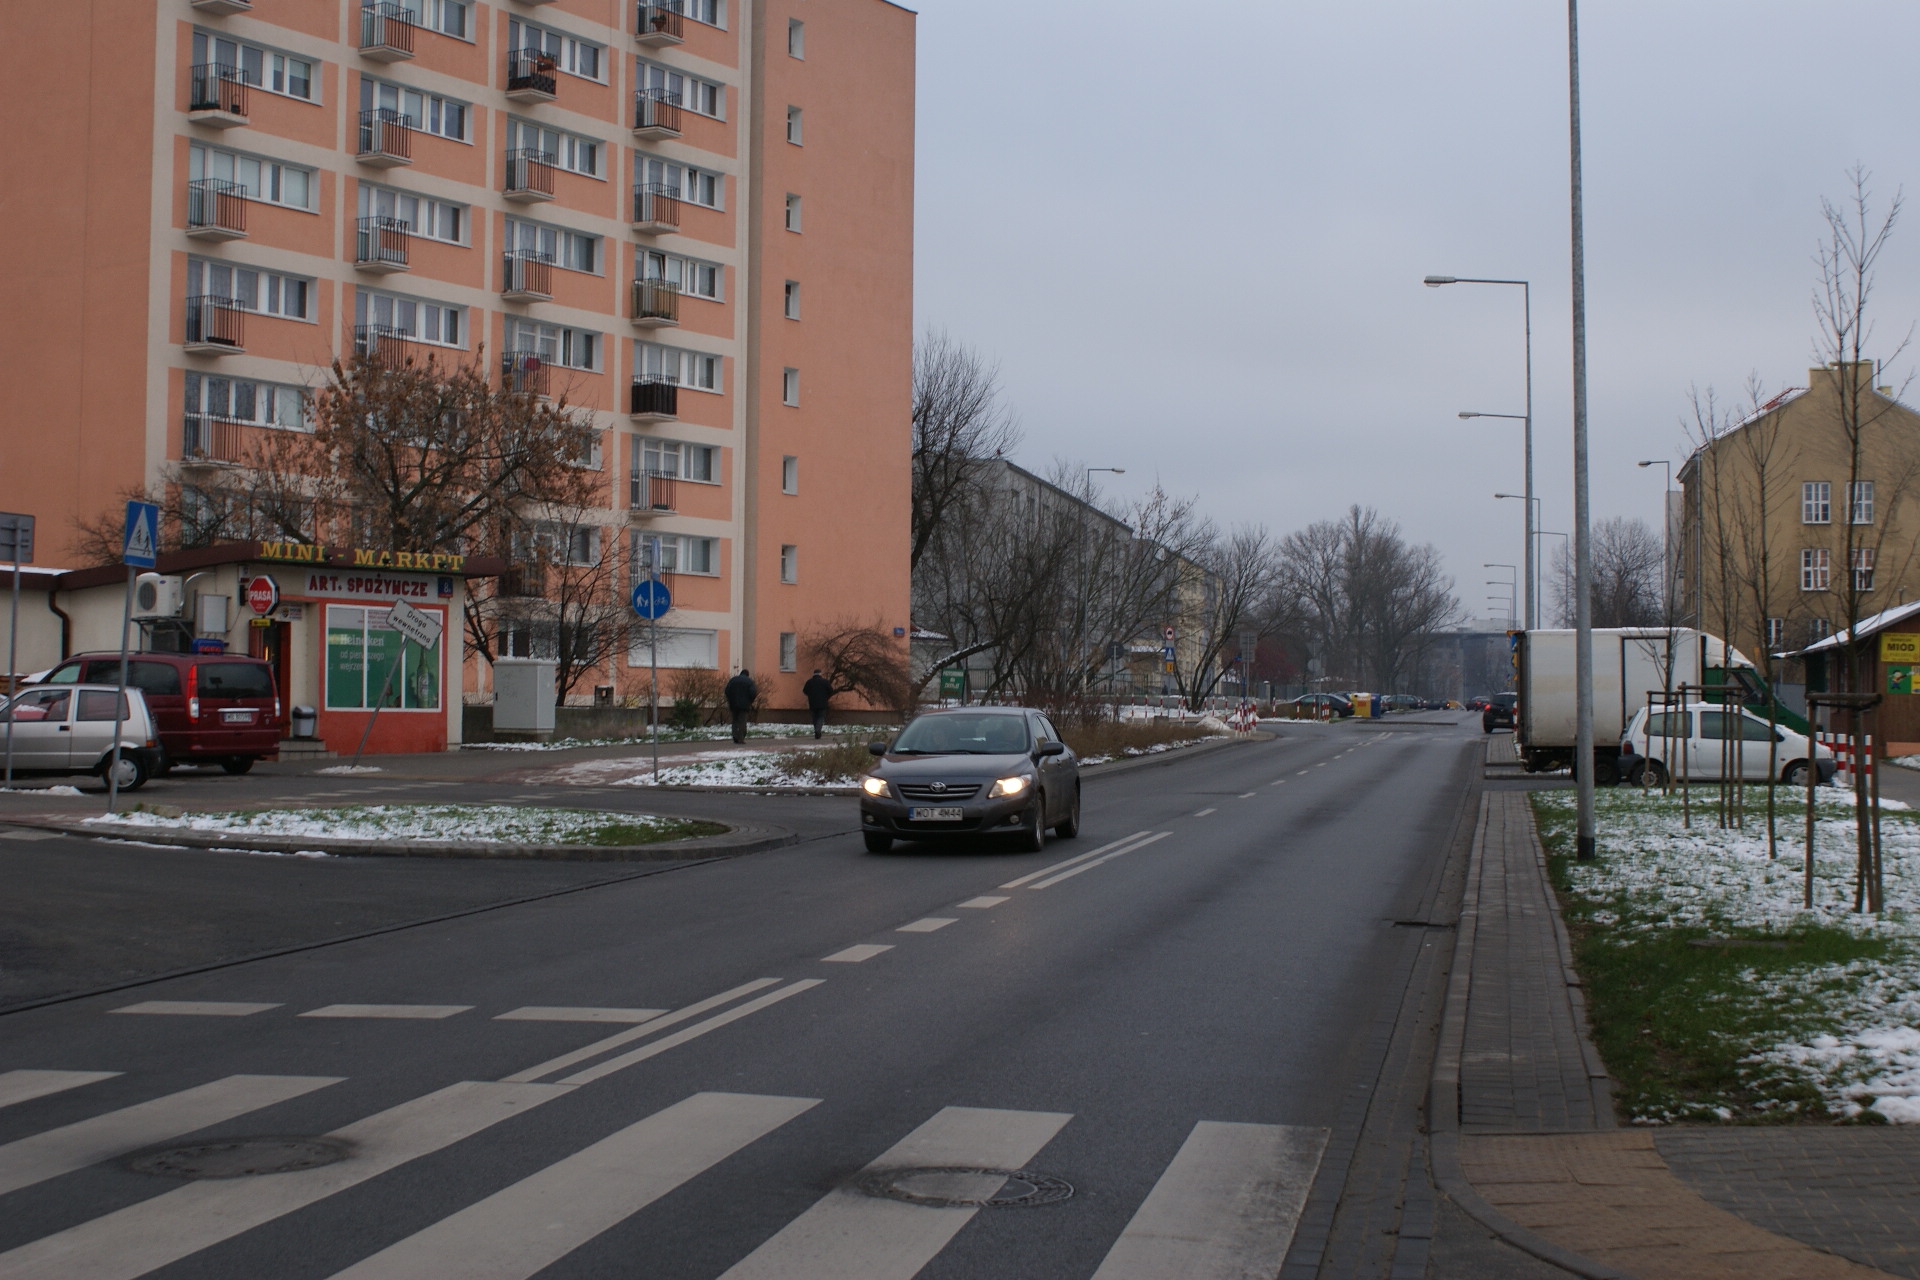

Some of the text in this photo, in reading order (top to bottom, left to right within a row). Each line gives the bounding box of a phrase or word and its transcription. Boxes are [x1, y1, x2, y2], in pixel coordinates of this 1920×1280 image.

[260, 541, 325, 562] MINI
[353, 547, 464, 571] MARKET
[250, 590, 272, 601] PRASA
[309, 573, 428, 597] ART. SPOŻYWCZE
[406, 610, 427, 629] Droga
